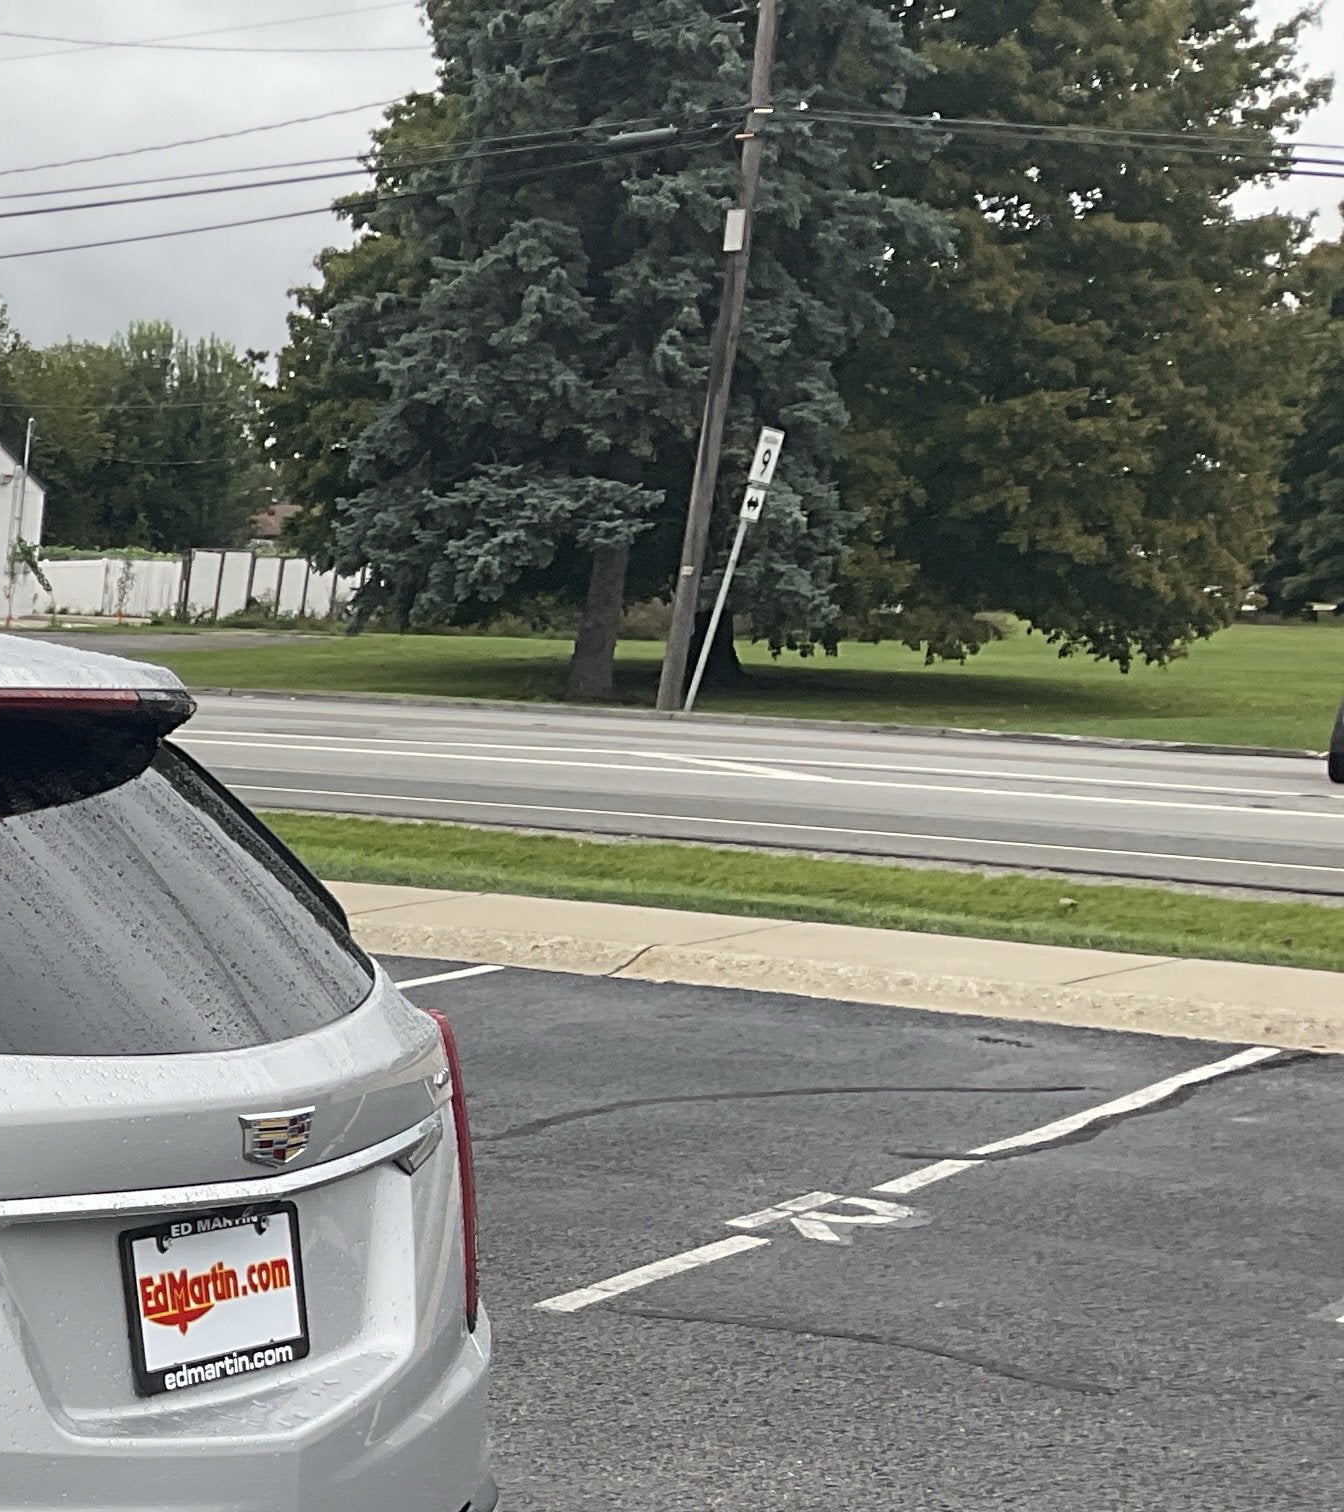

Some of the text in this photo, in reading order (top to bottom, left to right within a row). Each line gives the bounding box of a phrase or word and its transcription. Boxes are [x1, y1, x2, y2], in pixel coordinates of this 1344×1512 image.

[762, 447, 771, 478] 9
[170, 1222, 193, 1238] ED
[138, 1257, 292, 1320] EdMartin.com
[164, 1344, 294, 1391] edmartin.com
